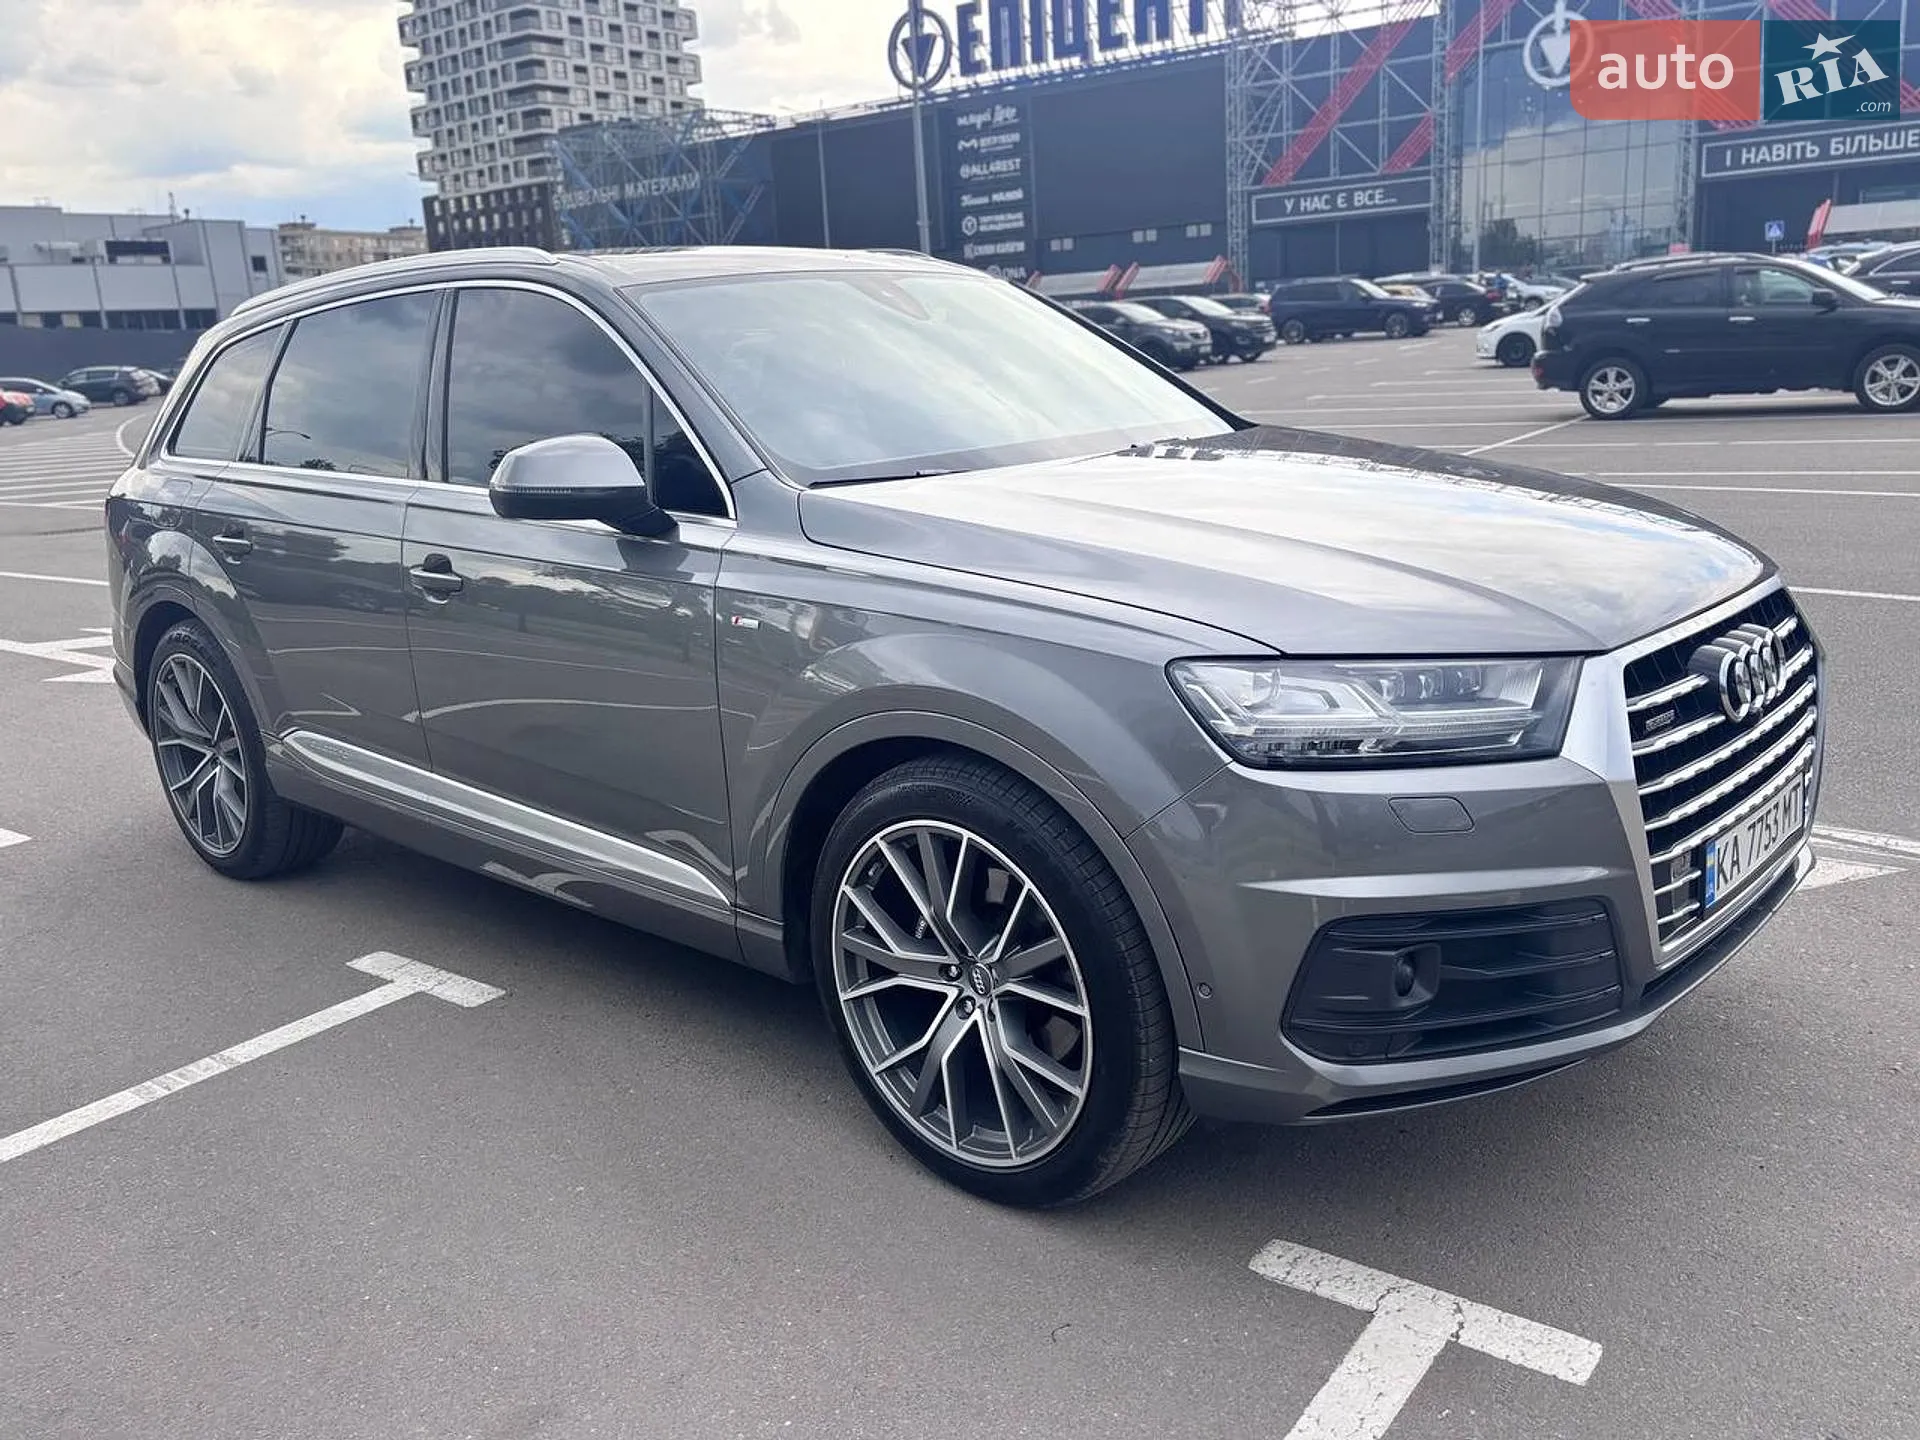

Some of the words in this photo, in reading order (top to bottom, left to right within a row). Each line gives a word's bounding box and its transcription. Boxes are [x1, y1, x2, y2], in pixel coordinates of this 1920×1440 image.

[1725, 149, 1732, 168] І
[1741, 140, 1820, 165] НАВІТЬ
[1829, 128, 1920, 156] БІЛЬШЕ
[1284, 198, 1296, 215] У
[1300, 194, 1332, 212] НАС
[1336, 192, 1348, 208] Є
[1716, 834, 1741, 891] KA
[1747, 801, 1779, 868] 7753
[1781, 780, 1801, 834] MT
